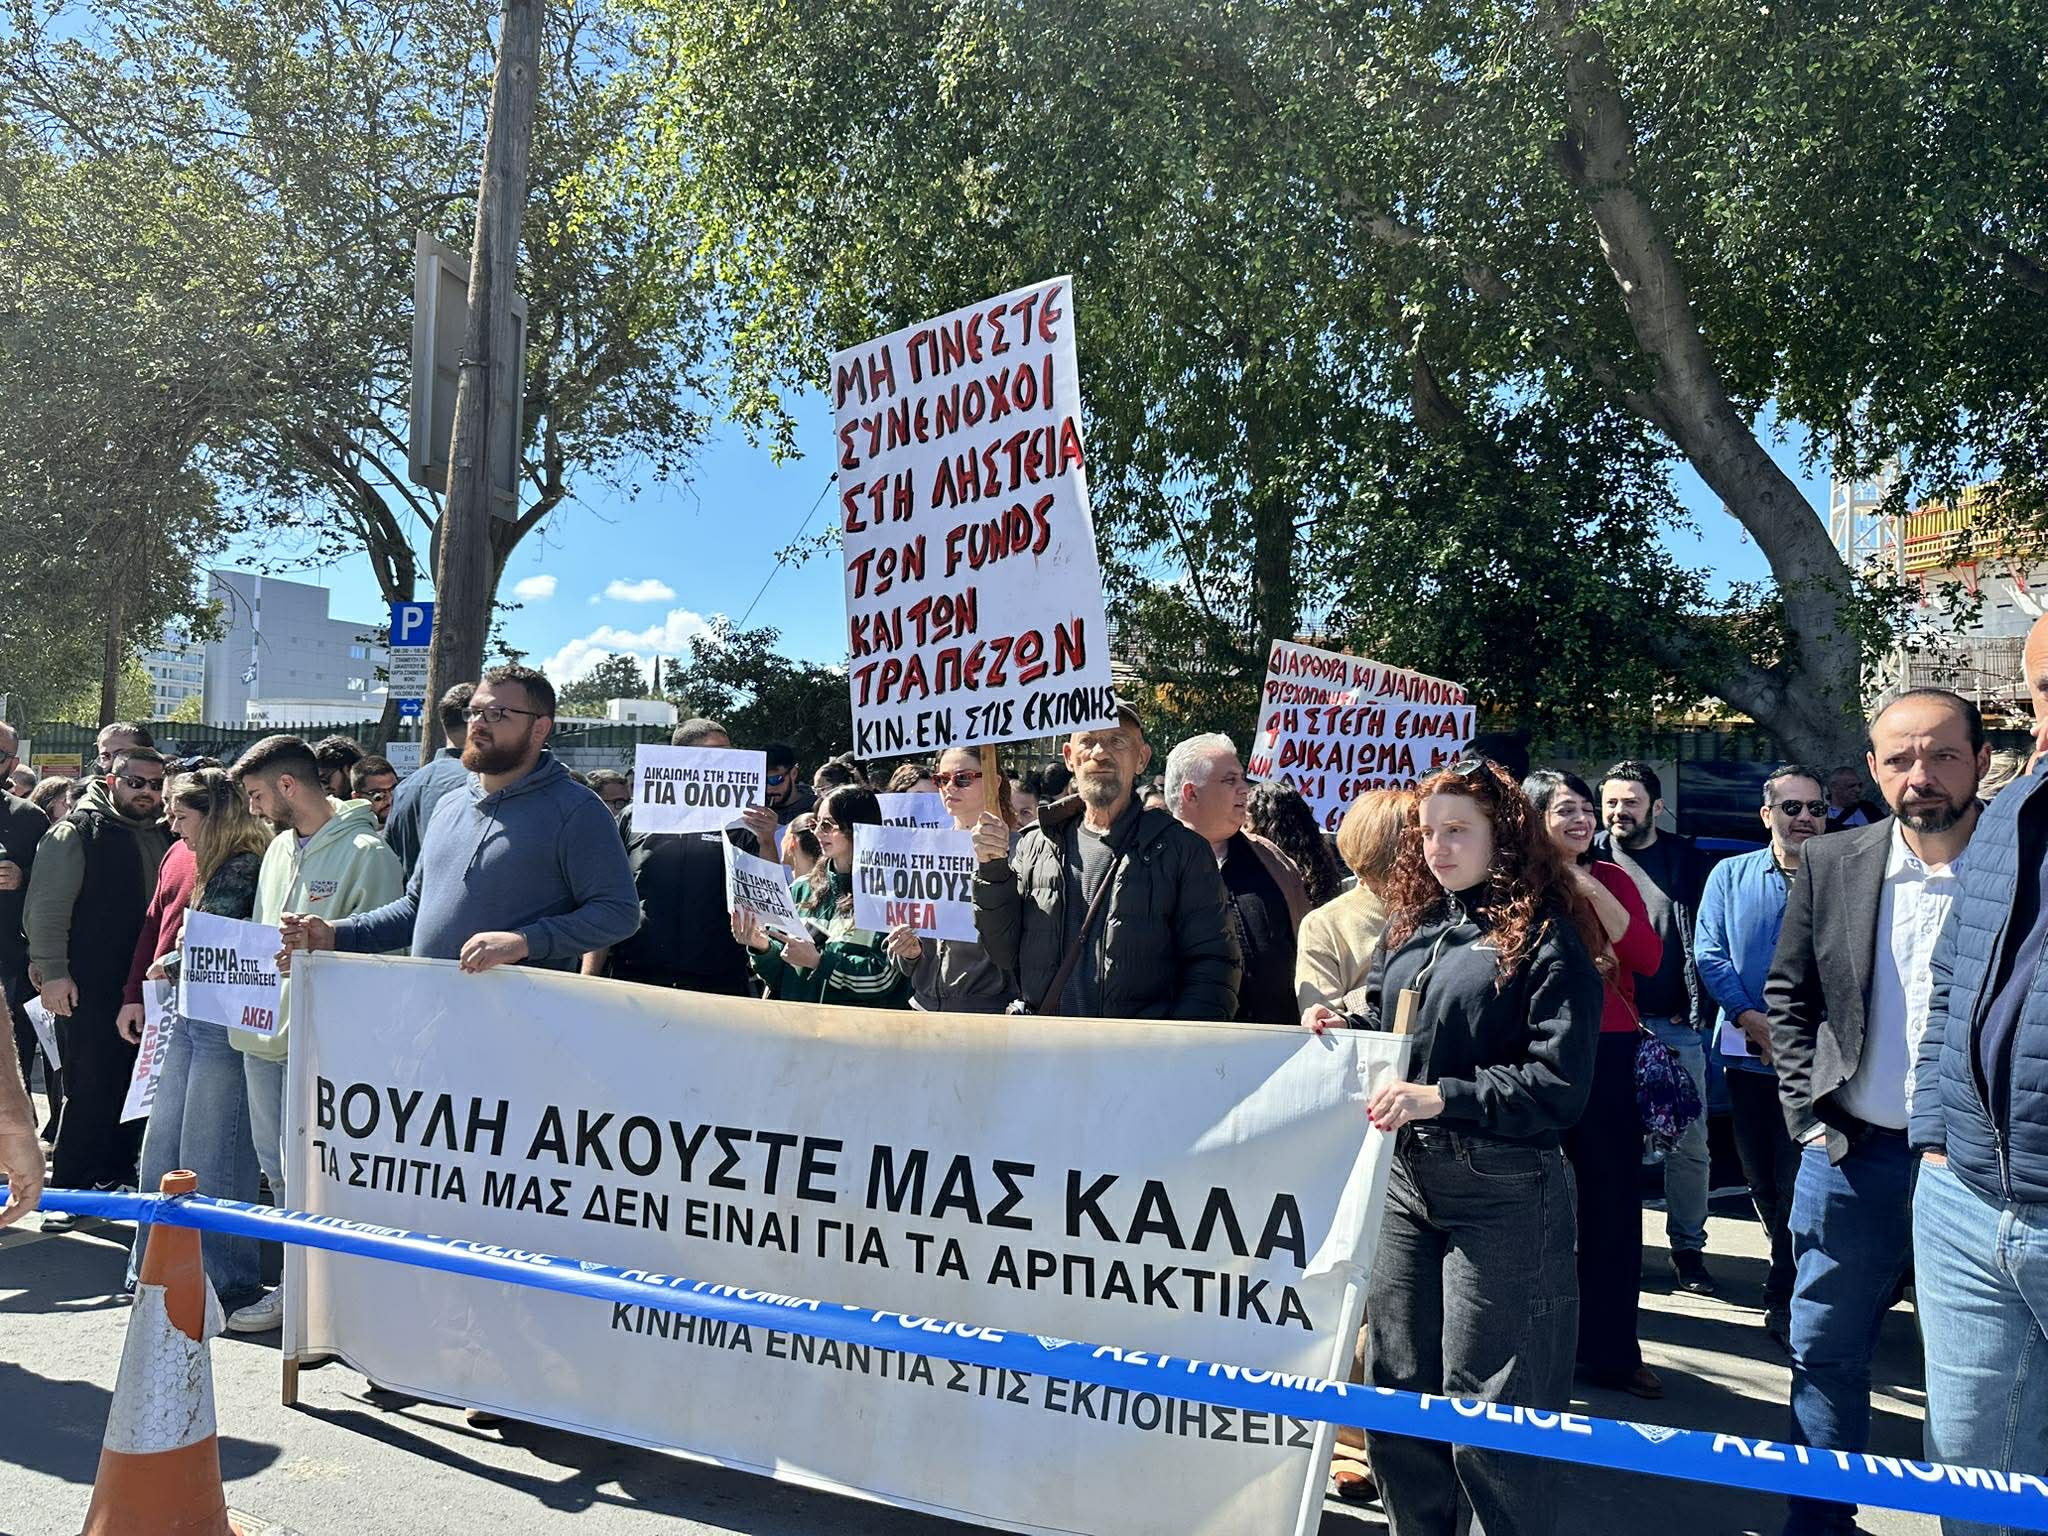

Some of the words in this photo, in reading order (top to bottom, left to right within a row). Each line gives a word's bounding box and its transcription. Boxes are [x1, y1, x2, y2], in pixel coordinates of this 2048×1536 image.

[836, 344, 896, 410] ΜΗ
[906, 284, 1063, 384] ΓΙΝΕΣΤΕ
[840, 353, 1054, 471] ΣΥΝΕΝΟΧΟΙ
[843, 467, 914, 533] ΣΤΗ
[931, 415, 1086, 508] ΛΗΣΤΕΙΑ
[847, 534, 926, 599] ΤΩΝ
[944, 494, 1055, 577] FUNDS
[401, 606, 424, 641] P
[852, 612, 1087, 708] ΤΡΑΠΕΖΩΝ
[1351, 664, 1376, 692] ΚΑΙ
[856, 713, 911, 757] ΚΙΝ.
[916, 707, 958, 747] ΕΝ.
[965, 699, 1014, 739] ΣΤΙΣ
[1304, 706, 1386, 738] ΣΤΕΓΗ
[1395, 709, 1471, 742] ΕΙΝΑΙ
[644, 767, 700, 782] ΔΙΚΑΙΩΜΑ
[703, 769, 724, 783] ΣΤΗ
[728, 771, 759, 785] ΣΤΕΓΗ
[1279, 739, 1416, 777] ΔΙΚΑΙΩΜΑ
[643, 780, 676, 805] ΓΙΑ
[684, 782, 758, 808] ΟΛΟΥΣ
[860, 849, 907, 869] ΔΙΚΑΙΩΜΑ
[911, 854, 934, 870] ΣΤΗ
[938, 855, 974, 872] ΣΤΕΓΗ
[860, 866, 887, 896] ΓΙΑ
[893, 869, 972, 902] ΟΛΟΥΣ
[886, 901, 936, 930] ΑΚΕΛ
[190, 946, 239, 972] ΤΕΡΜΑ
[241, 959, 260, 973] ΣΤΙΣ
[228, 972, 276, 986] ΕΚΠΟΙΗΣΕΙΣ
[241, 1005, 273, 1031] ΑΚΕΛ
[317, 1075, 509, 1156] ΒΟΥΛΗ
[526, 1105, 843, 1204] ΑΚΟΥΣΤΕ
[865, 1144, 1035, 1231] ΜΑΣ
[1065, 1169, 1307, 1270] ΚΑΛΑ
[313, 1140, 341, 1182] ΤΑ
[348, 1151, 467, 1203] ΣΠΙΤΙΑ
[482, 1170, 572, 1217] ΜΑΣ
[582, 1185, 669, 1231] ΔΕΝ
[685, 1198, 799, 1254] ΕΙΝΑΙ
[817, 1218, 890, 1268] ΓΙΑ
[905, 1232, 970, 1280] ΤΑ
[987, 1245, 1314, 1332] ΑΡΠΑΚΤΙΚΑ
[611, 1301, 753, 1353] ΚΙΝΗΜΑ
[765, 1328, 935, 1386] ΕΝΑΝΤΙΑ
[947, 1359, 1032, 1405] ΣΤΙΣ
[1044, 1375, 1314, 1449] ΕΚΠΟΙΗΣΕΙΣ
